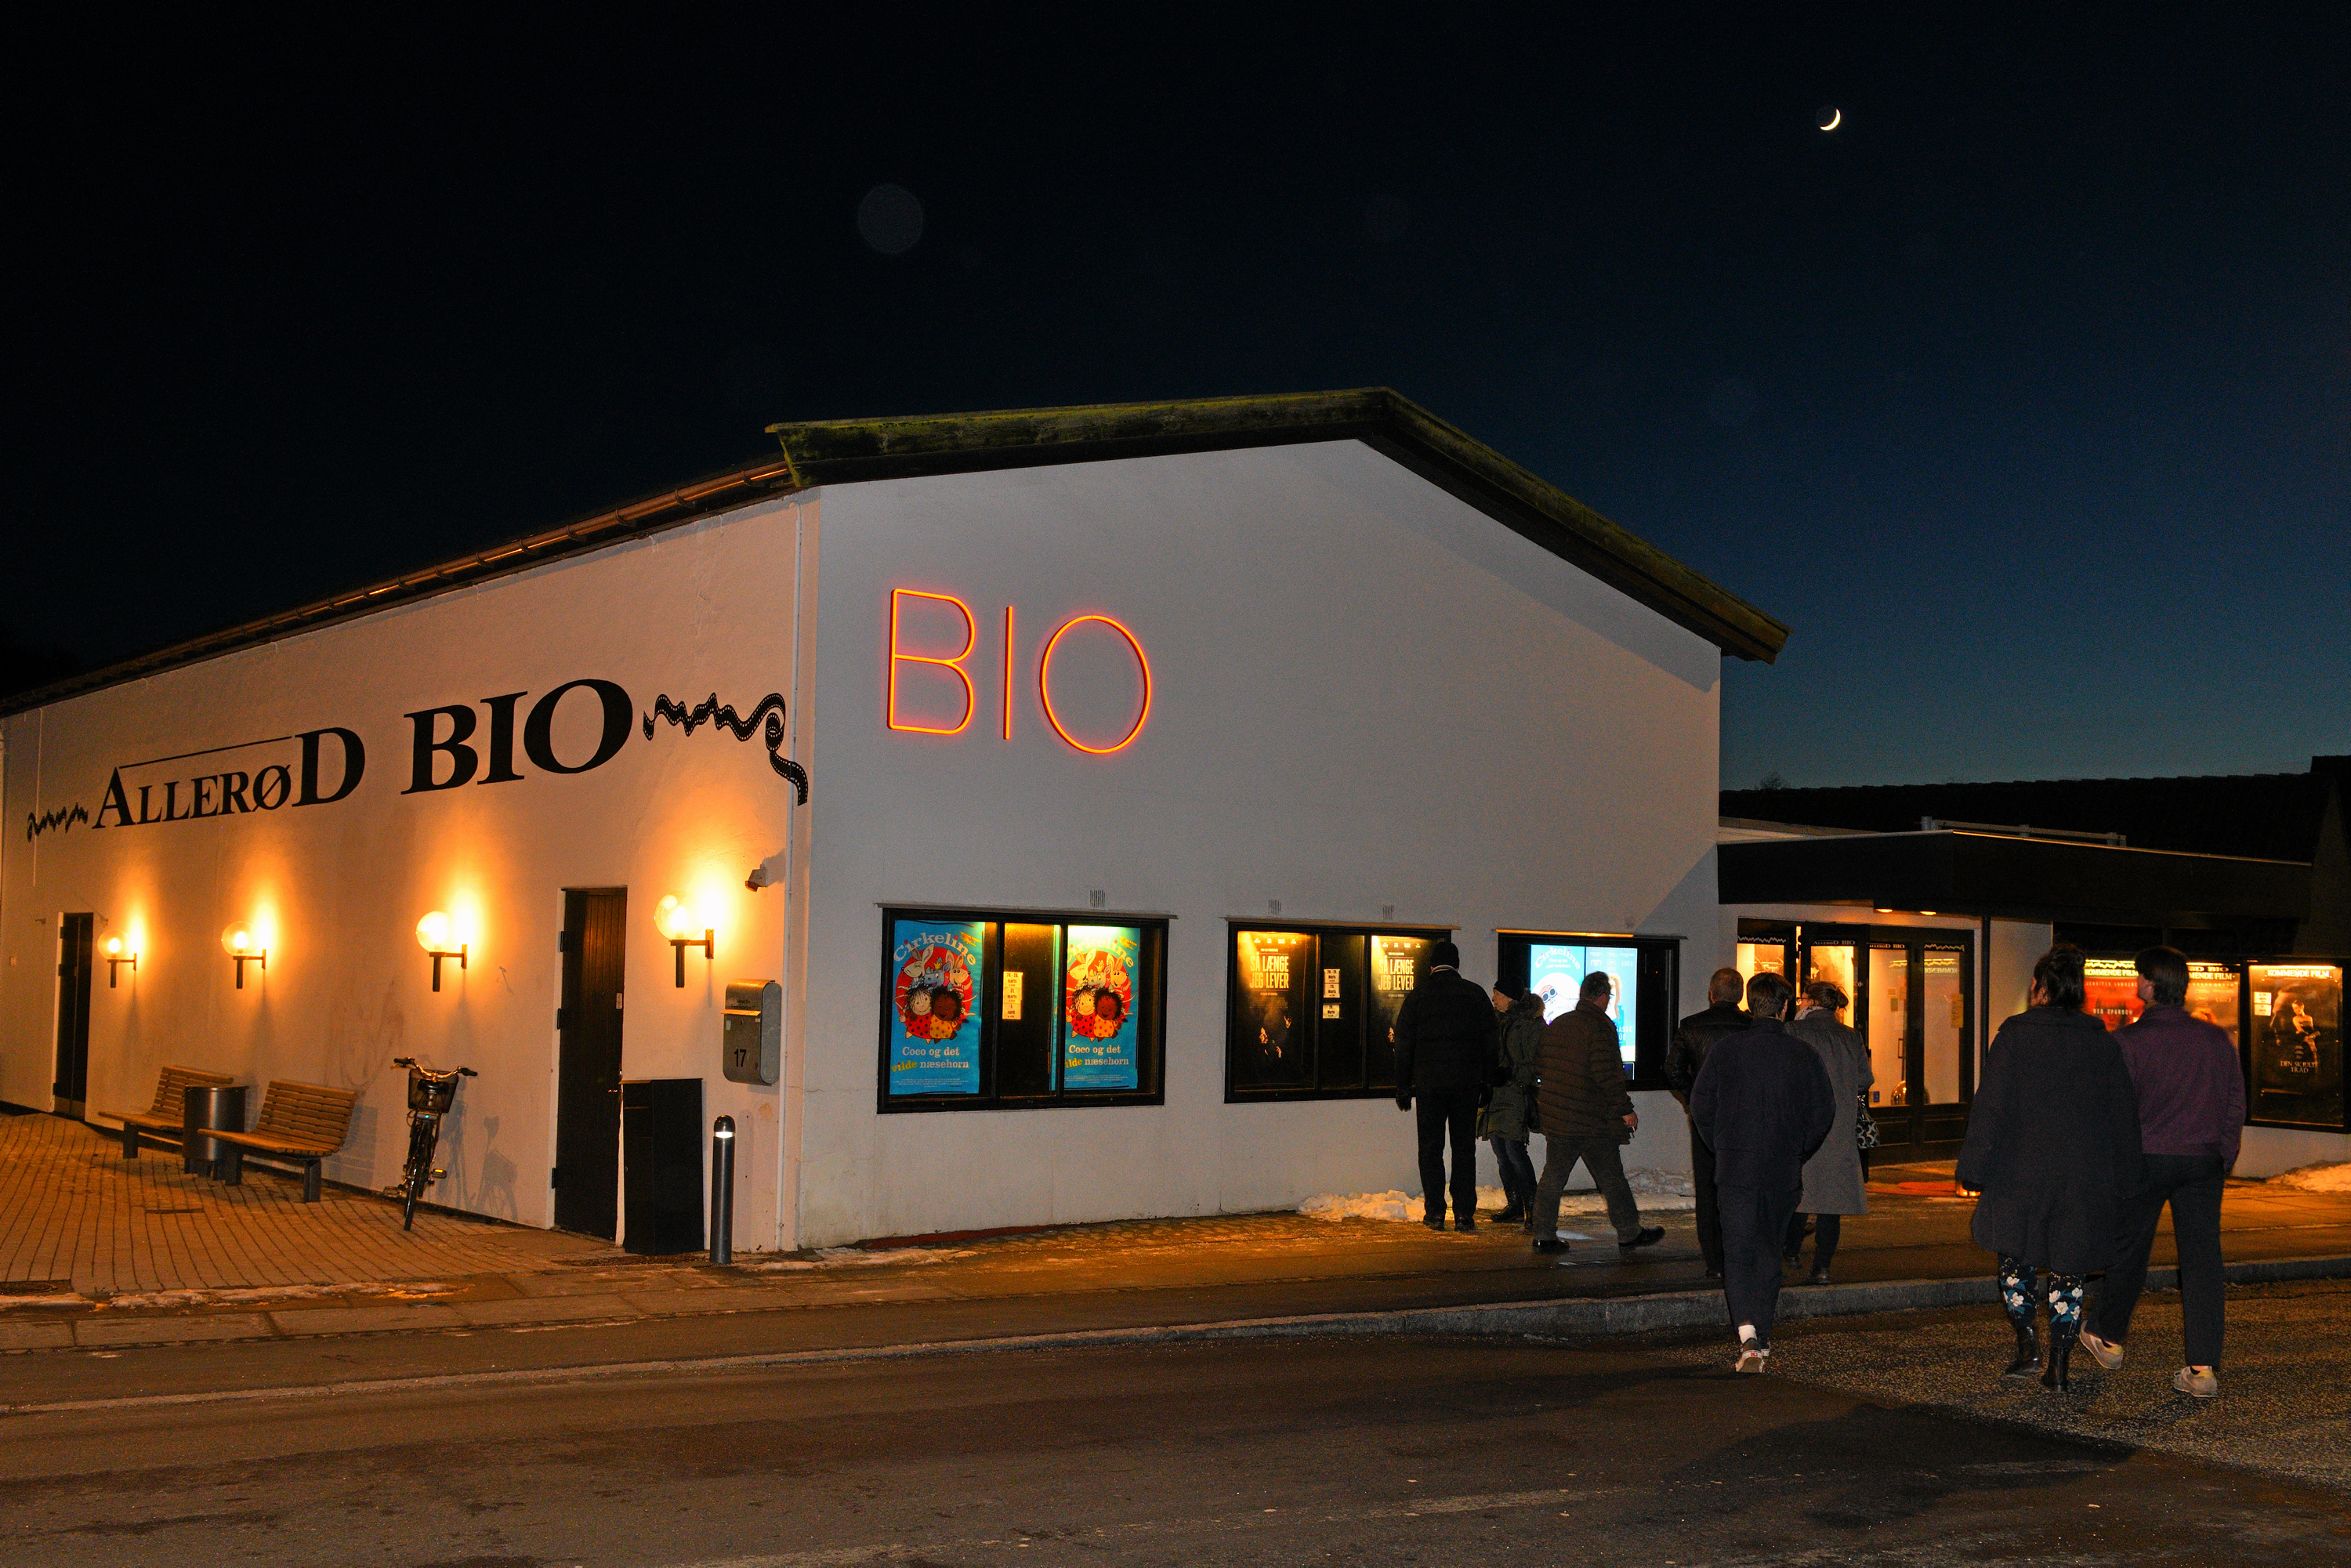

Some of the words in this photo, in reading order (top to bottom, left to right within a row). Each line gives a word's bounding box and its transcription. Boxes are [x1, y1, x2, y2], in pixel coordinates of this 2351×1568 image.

[887, 588, 1150, 753] BIO
[92, 727, 365, 829] ALLERØD
[400, 679, 633, 795] BIO
[893, 932, 976, 965] Cirkeline
[1535, 947, 1581, 969] Cirkeline
[1250, 951, 1261, 972] SÅ
[1262, 956, 1289, 972] LÆNGE
[1378, 954, 1389, 974] SÅ
[1389, 959, 1415, 975] LÆNGE
[1249, 972, 1263, 988] JEG
[1266, 972, 1289, 988] LEVER
[1378, 975, 1391, 990] JEG
[1393, 975, 1414, 990] LEVER
[734, 1048, 747, 1067] 17
[902, 1046, 926, 1056] Coco
[929, 1048, 941, 1058] og
[944, 1046, 960, 1056] det
[1068, 1045, 1090, 1053] Coco
[1092, 1047, 1104, 1056] og
[1107, 1045, 1121, 1053] det
[892, 1060, 918, 1072] vilde
[919, 1059, 969, 1068] næsehorn
[1065, 1057, 1082, 1068] ilde
